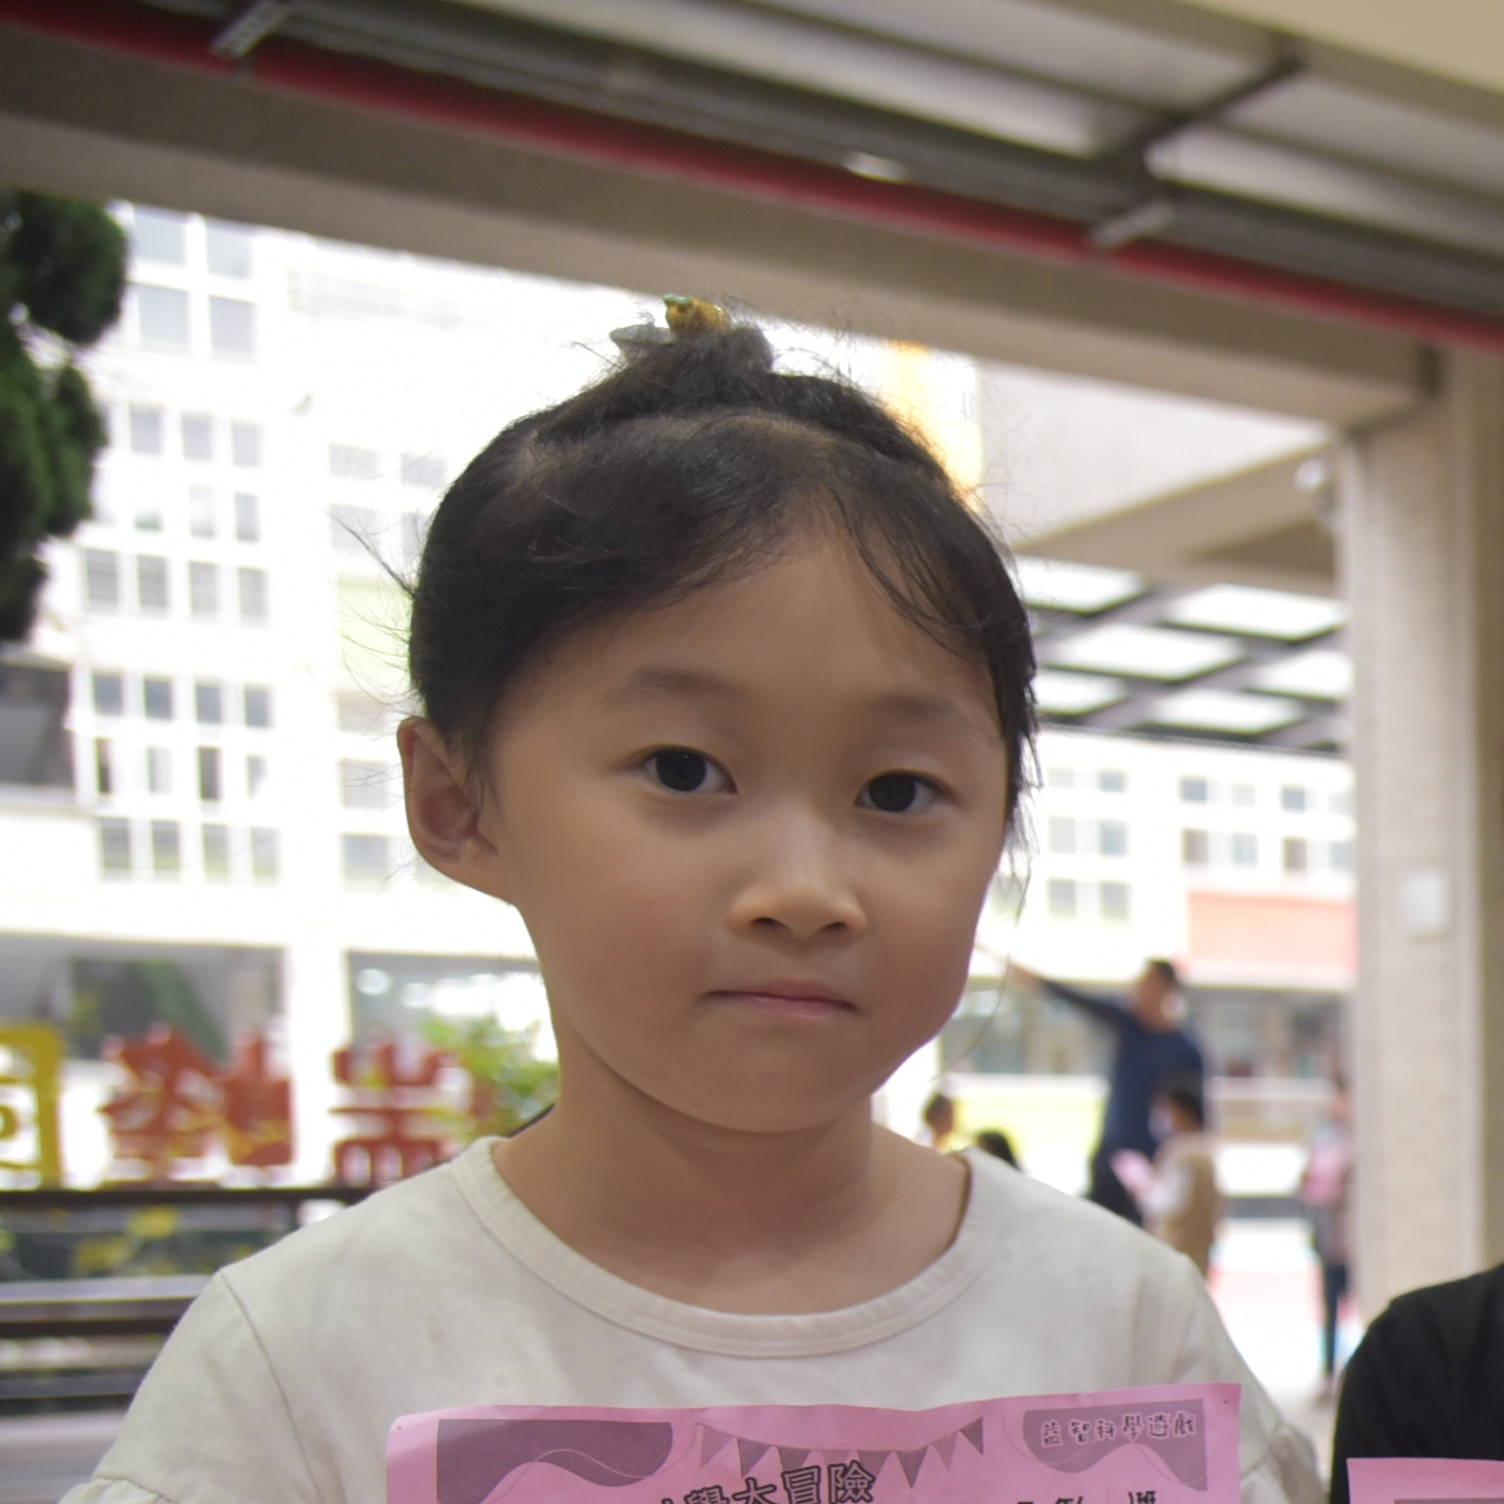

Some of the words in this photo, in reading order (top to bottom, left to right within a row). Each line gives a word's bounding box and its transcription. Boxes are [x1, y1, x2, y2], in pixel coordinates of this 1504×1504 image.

[1041, 1412, 1196, 1448] 益智科學遊戲
